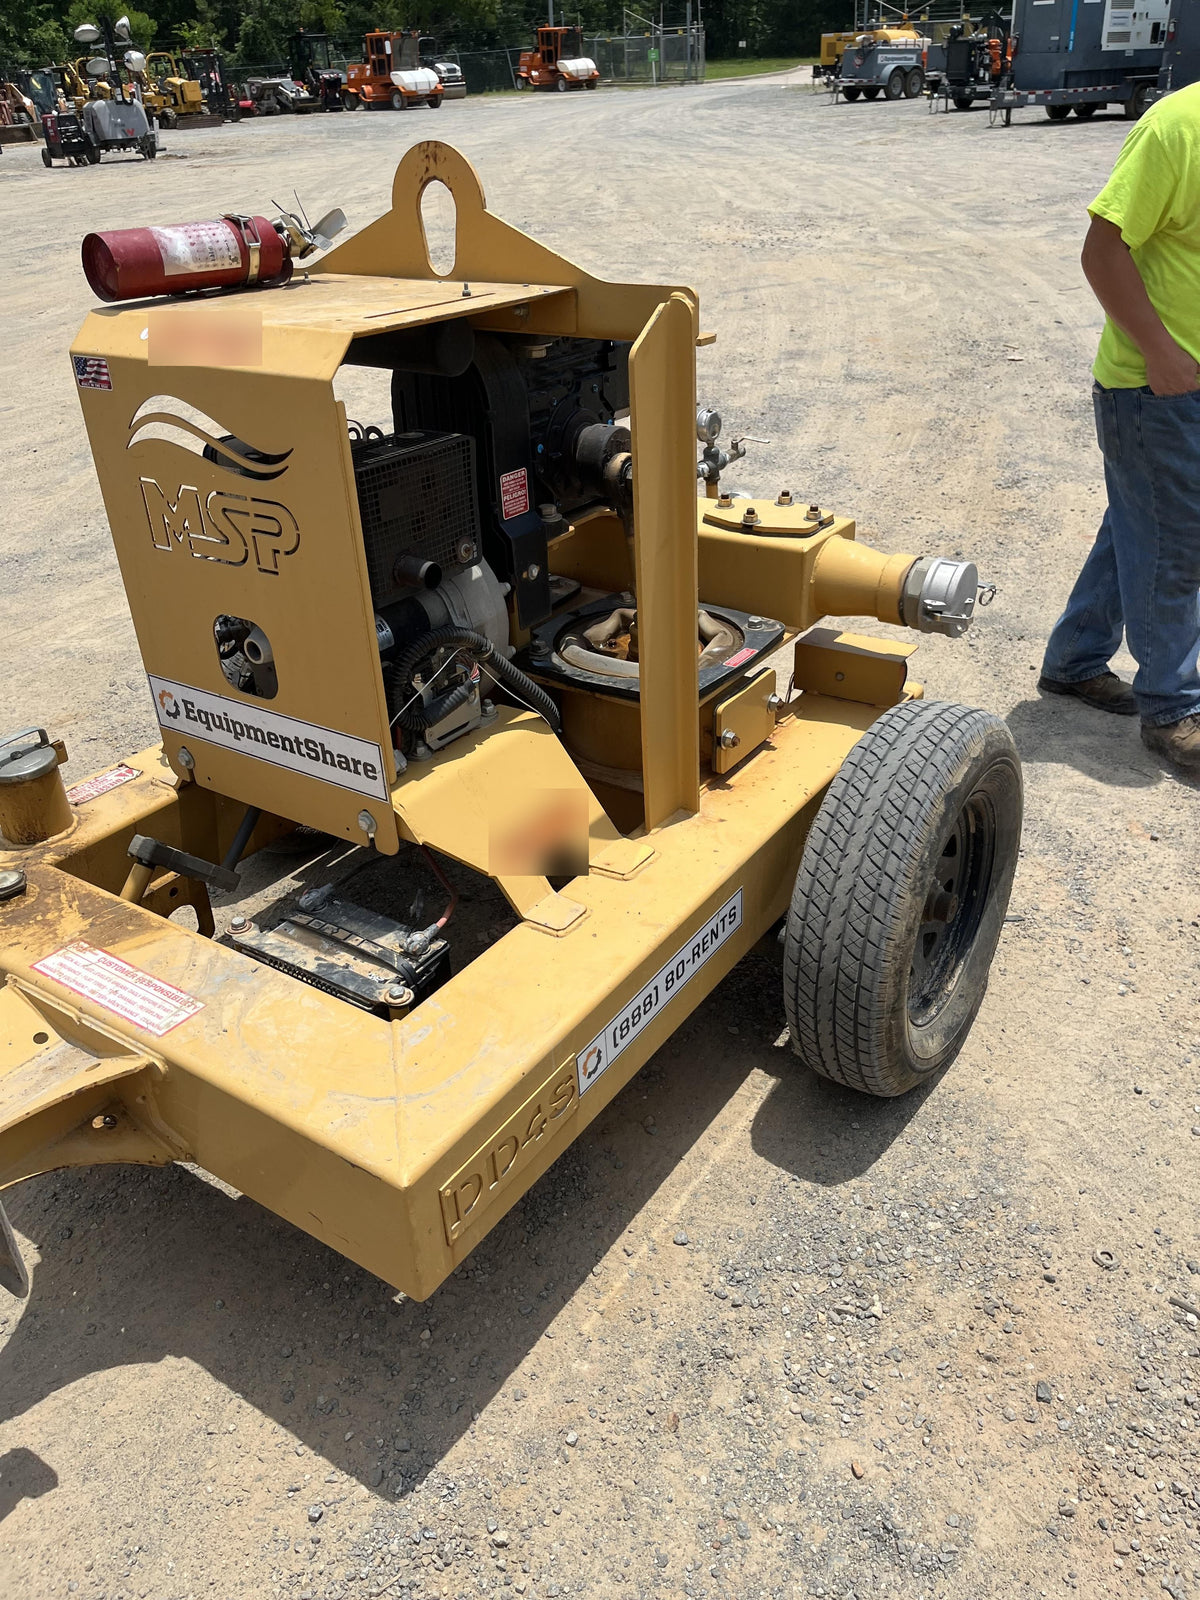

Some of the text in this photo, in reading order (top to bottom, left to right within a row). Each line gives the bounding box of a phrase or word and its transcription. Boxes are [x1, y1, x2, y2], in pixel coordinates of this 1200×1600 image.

[502, 470, 526, 483] DANGER
[140, 476, 300, 577] MSP
[181, 698, 378, 781] EquipmentShare
[95, 778, 123, 793] DIESEL
[97, 956, 199, 1011] CUSTOMER RESPONSIBILITY
[612, 904, 737, 1049] (888) 80-RENTS
[449, 1074, 576, 1232] DD4S
